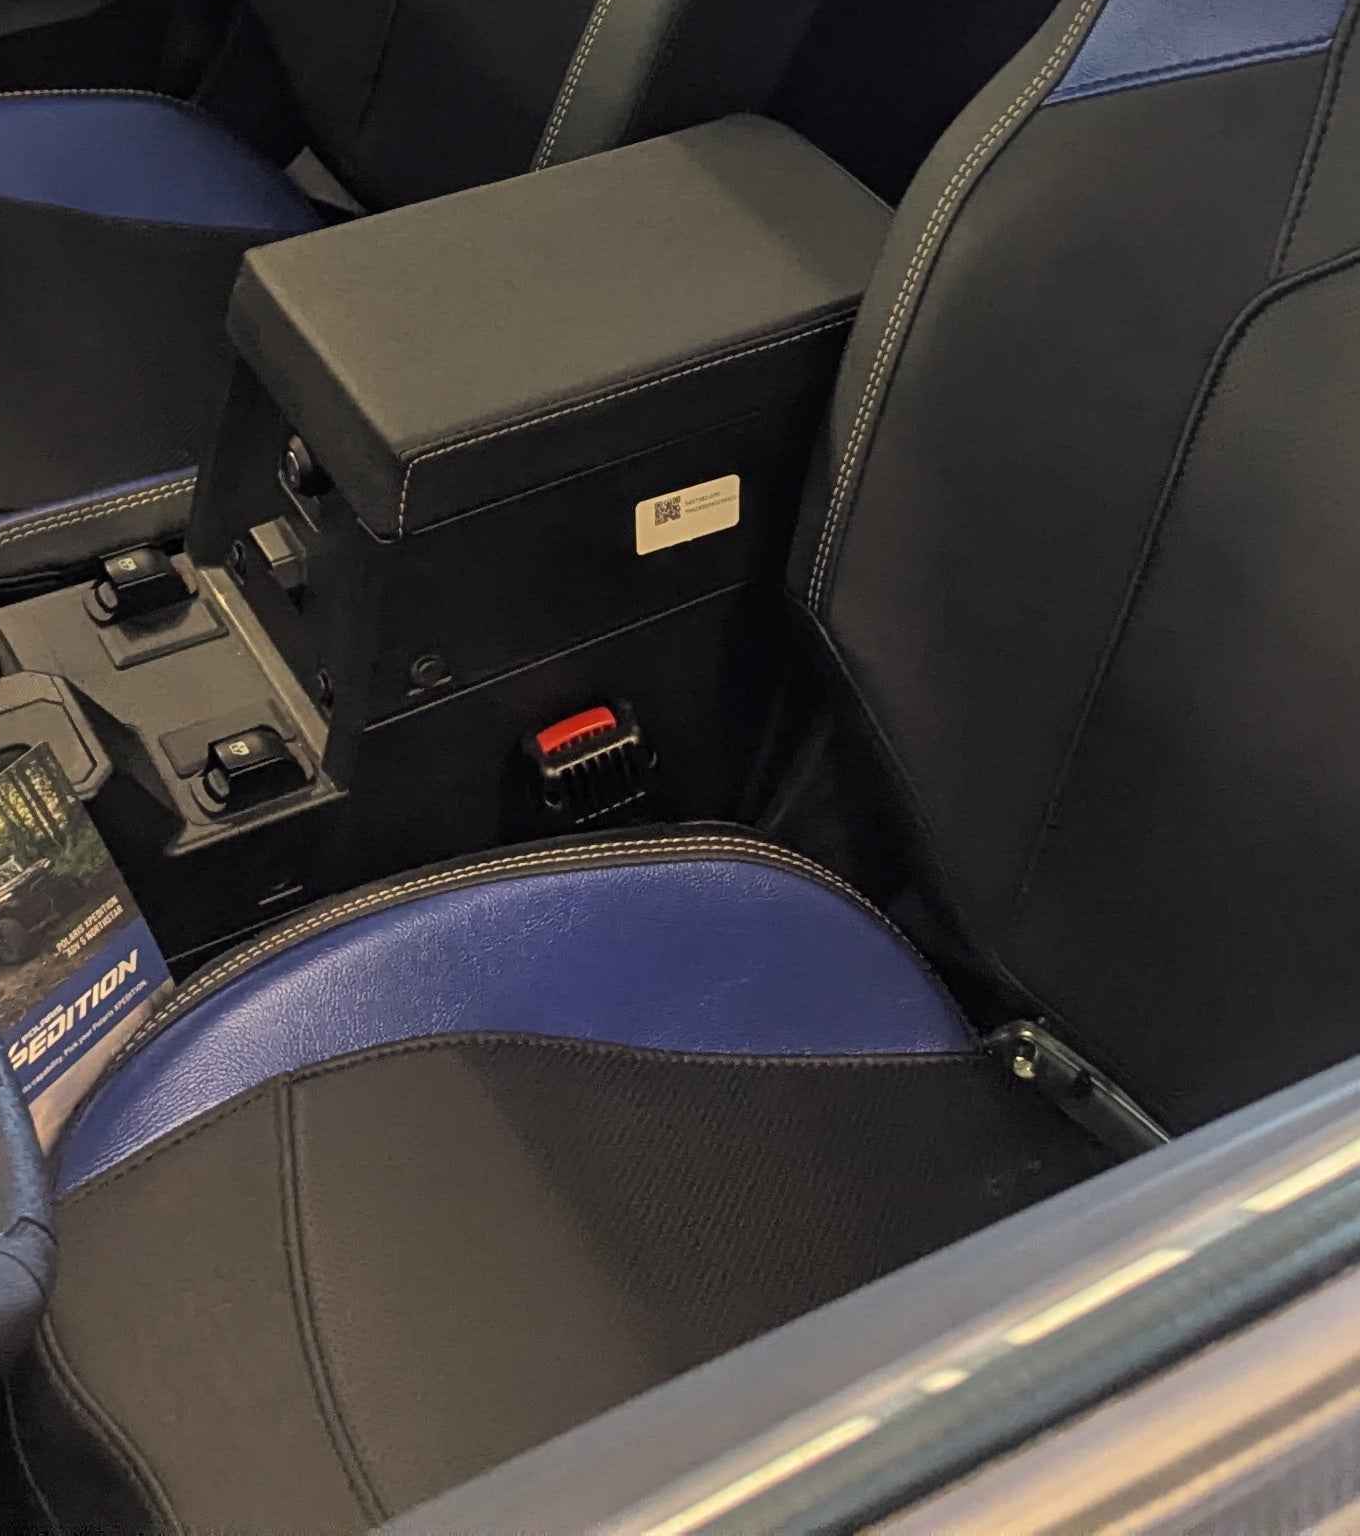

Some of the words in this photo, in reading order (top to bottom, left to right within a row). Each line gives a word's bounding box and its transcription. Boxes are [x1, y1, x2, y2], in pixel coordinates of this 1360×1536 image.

[55, 923, 85, 952] POLARIS
[84, 895, 119, 930] XPEDITION
[85, 904, 124, 942] NORTHSTAR
[21, 1003, 64, 1043] POLARIS
[92, 1009, 115, 1033] Polaris
